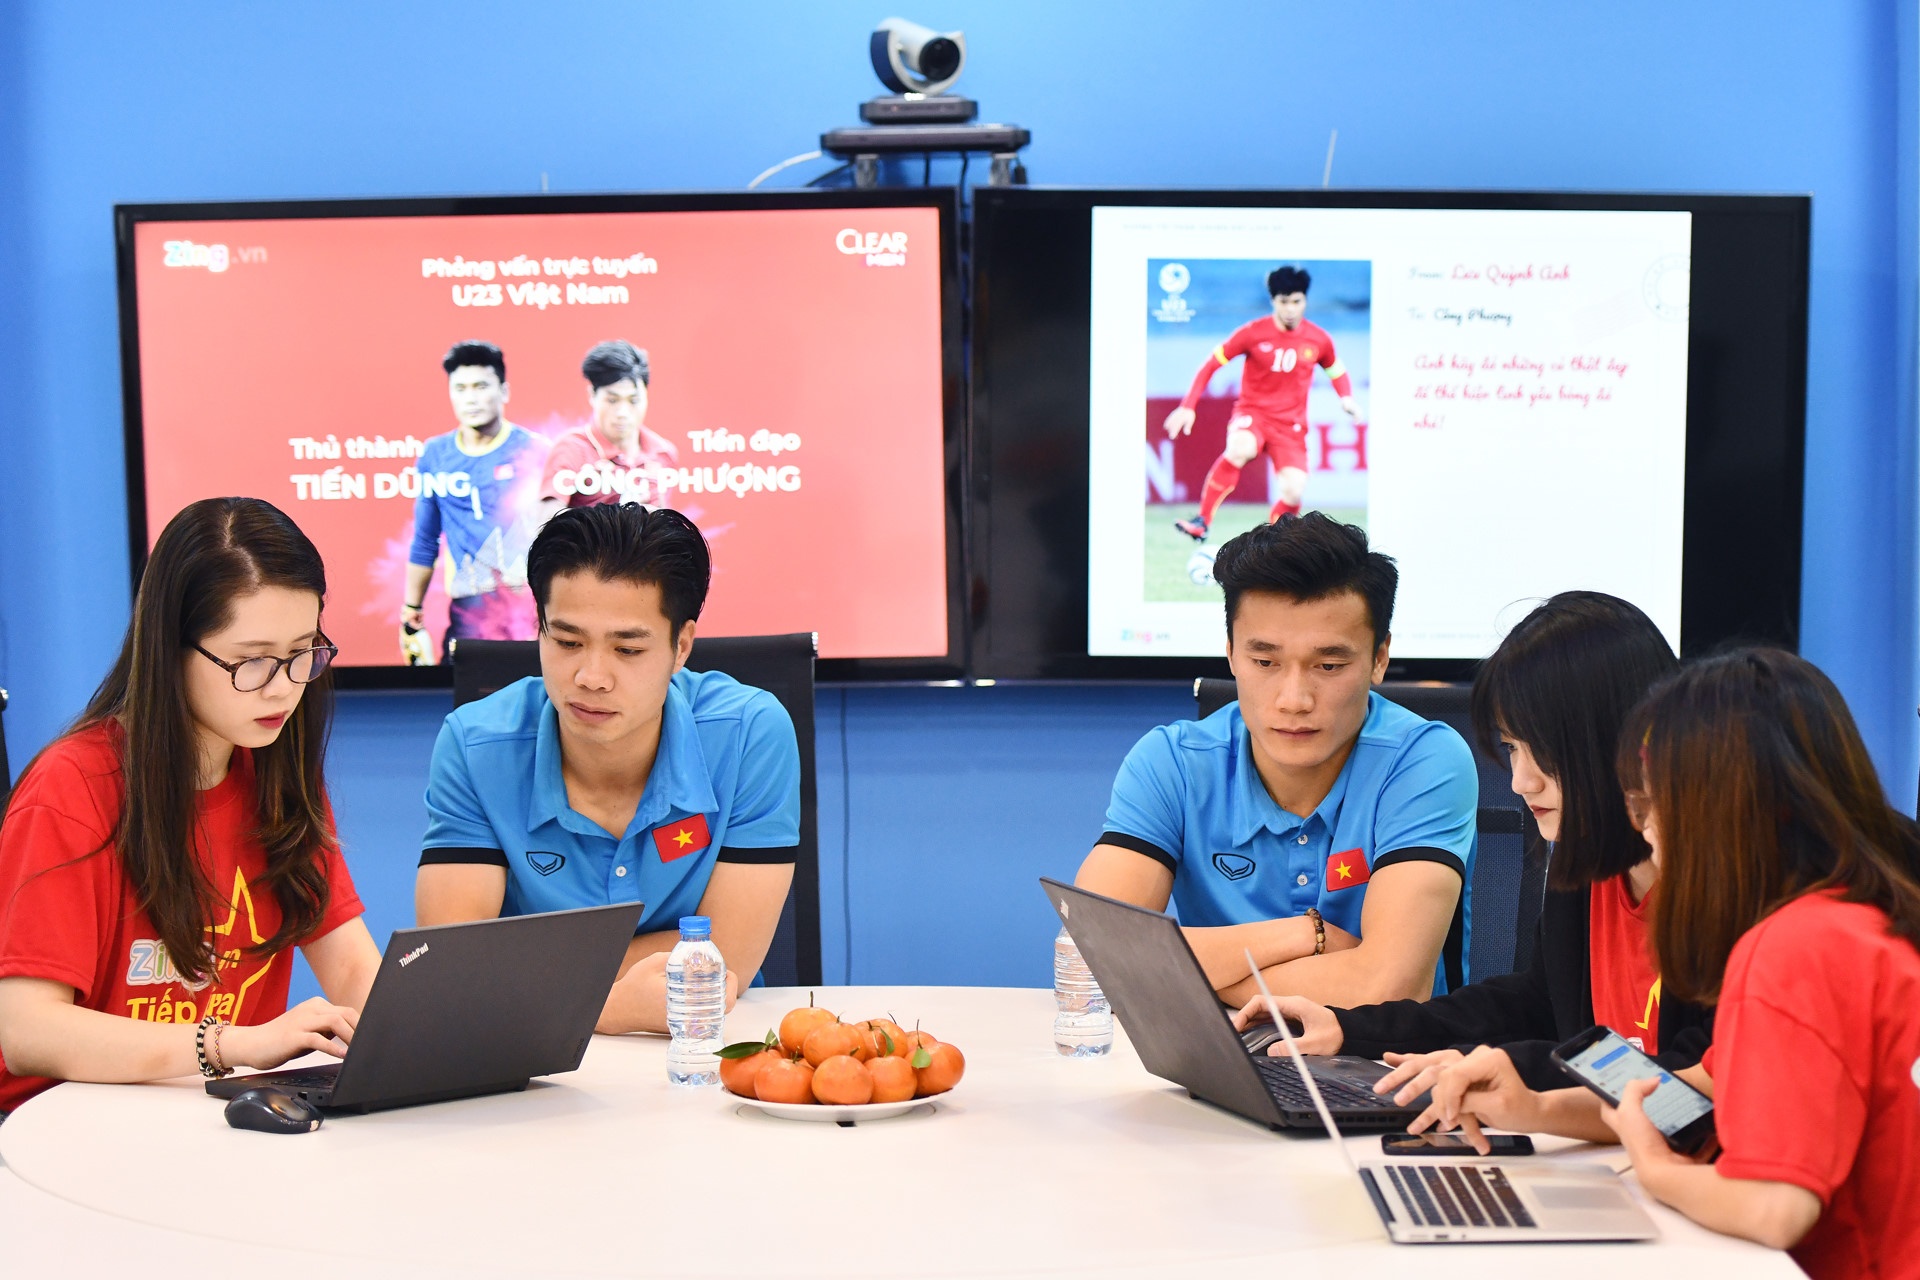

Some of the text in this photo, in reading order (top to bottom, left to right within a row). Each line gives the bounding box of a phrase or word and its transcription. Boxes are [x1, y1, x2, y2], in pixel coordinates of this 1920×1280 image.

[836, 228, 908, 254] CLEAR
[163, 240, 268, 273] Zing.vn
[421, 252, 658, 281] Phỏng vấn trực tuyến
[452, 281, 629, 310] U23 Việt Nam
[1270, 348, 1297, 372] 10
[288, 434, 424, 460] Thủ thành
[749, 429, 801, 456] đạo
[289, 465, 472, 500] TIẾN DŨNG
[552, 462, 801, 499] CÔNG PHƯỢNG
[398, 942, 429, 968] ThinkPad
[126, 987, 198, 1024] Tiếp
